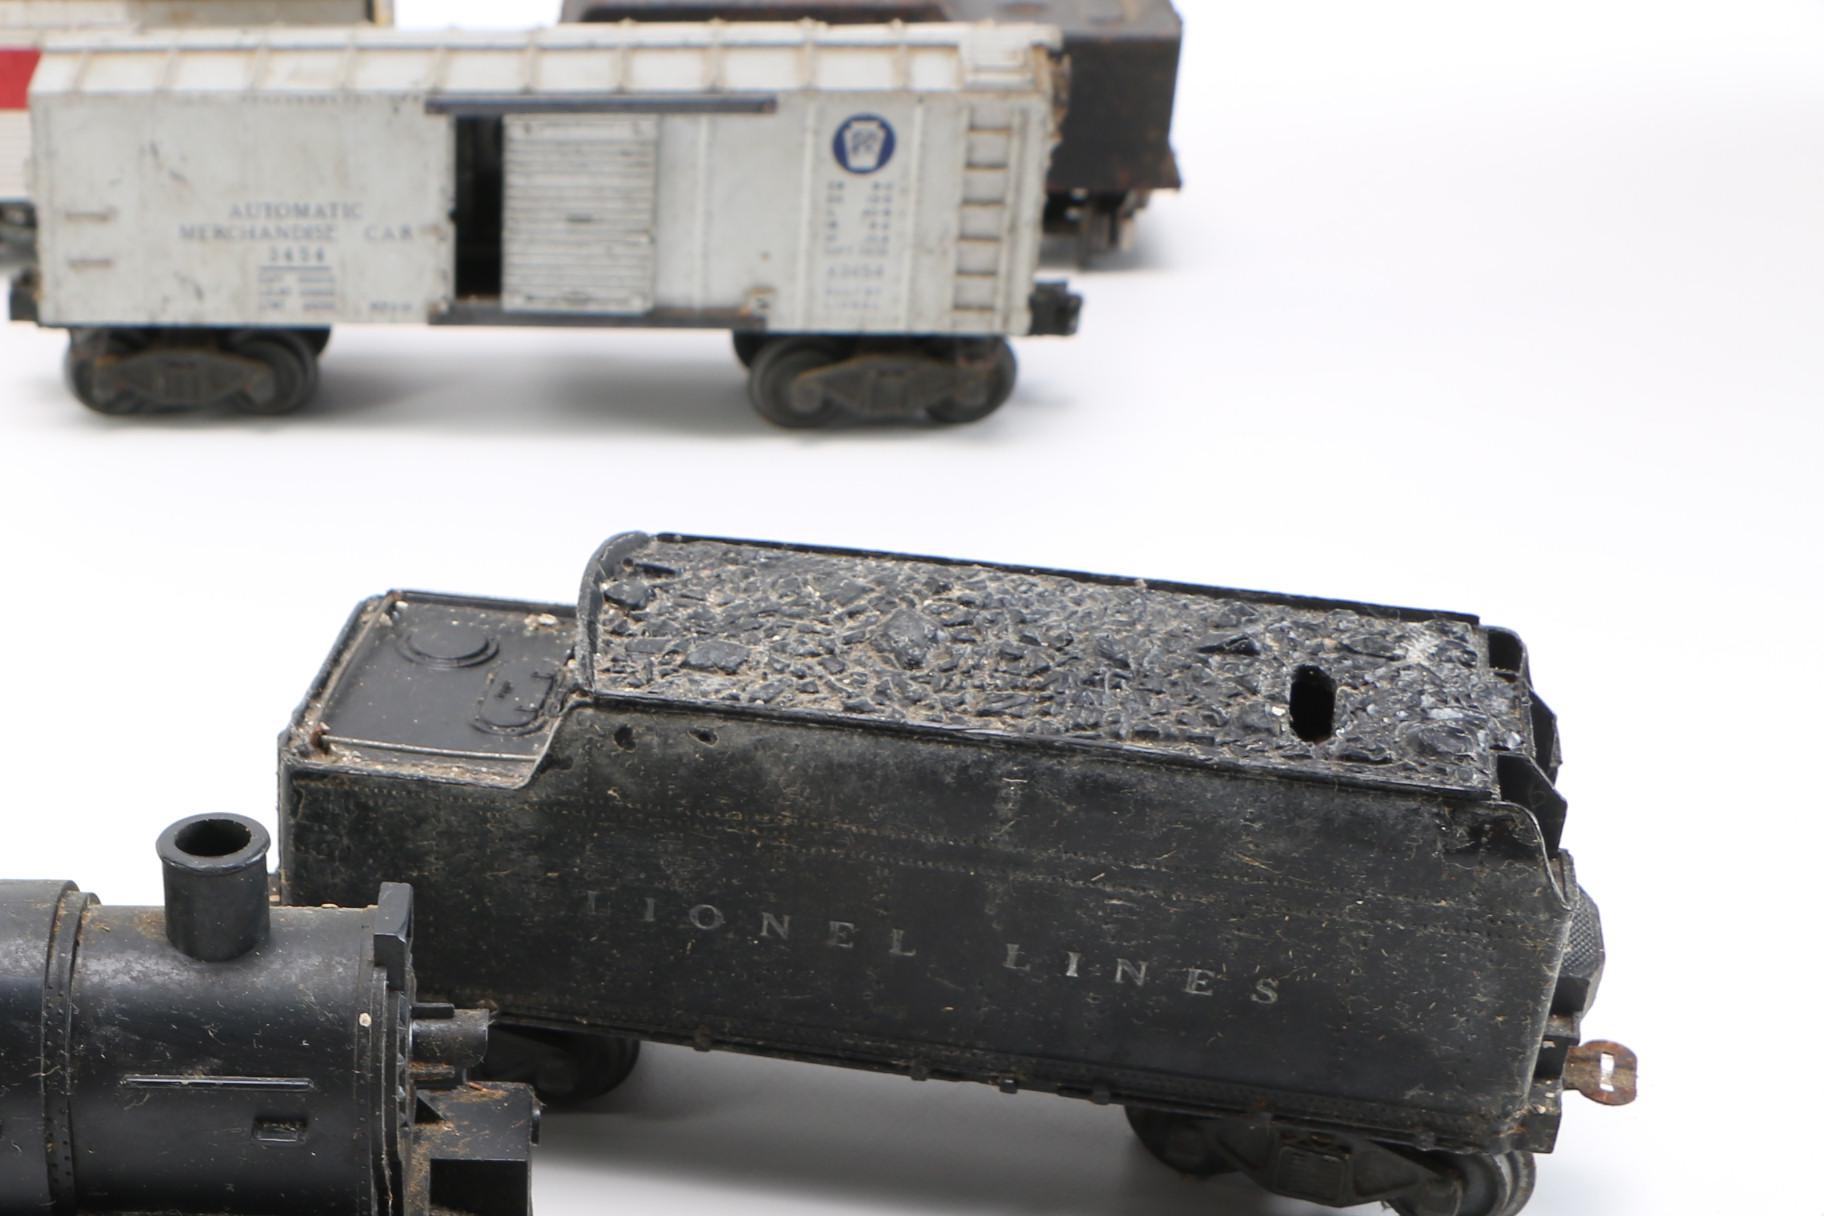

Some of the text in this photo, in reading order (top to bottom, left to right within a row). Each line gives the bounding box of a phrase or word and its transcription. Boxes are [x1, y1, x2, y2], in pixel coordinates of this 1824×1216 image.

[229, 201, 364, 220] AUTOMATIC
[179, 223, 414, 242] MERCHANDISE CAR
[586, 889, 1279, 1005] LIONEL LINES
